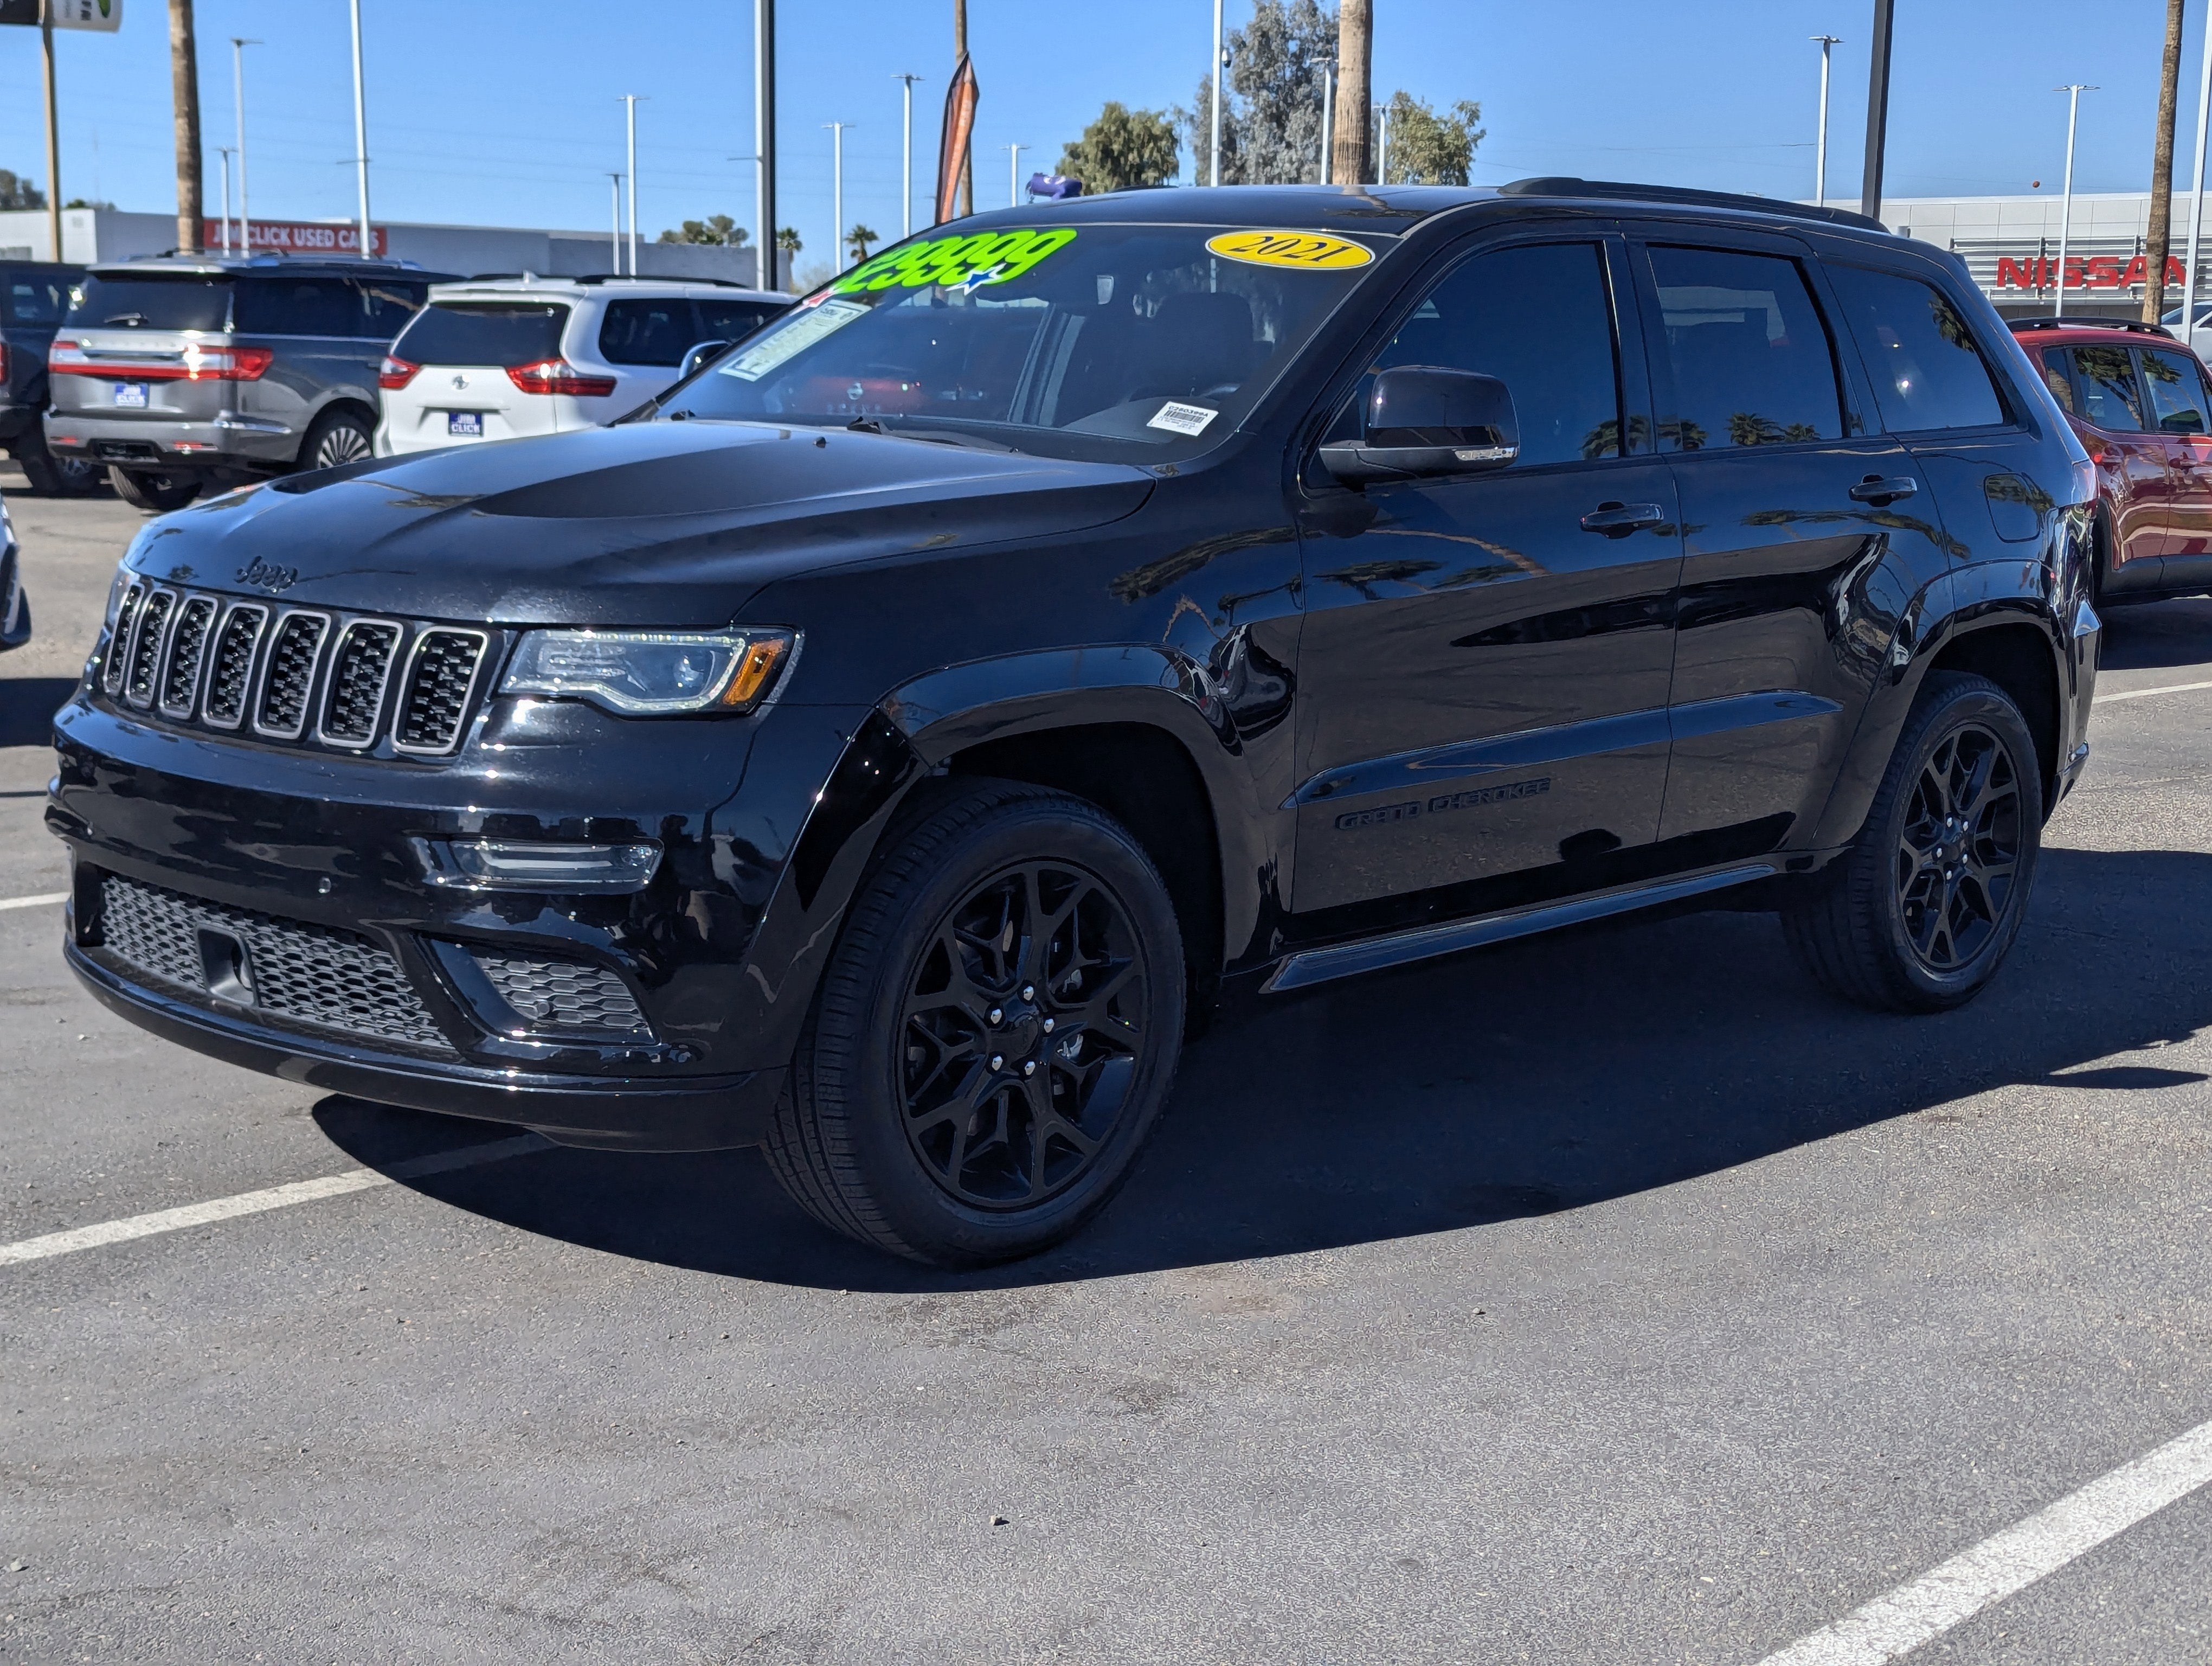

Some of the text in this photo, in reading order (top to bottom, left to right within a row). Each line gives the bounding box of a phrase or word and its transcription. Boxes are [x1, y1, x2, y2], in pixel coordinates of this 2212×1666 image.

[213, 223, 379, 250] JM CLICK USED CAS
[1226, 236, 1354, 262] 2021
[1997, 256, 2187, 288] NISSAN
[451, 424, 480, 433] CLICK
[234, 555, 298, 594] Jeep
[1335, 777, 1551, 830] GRAND CHEROKEE
